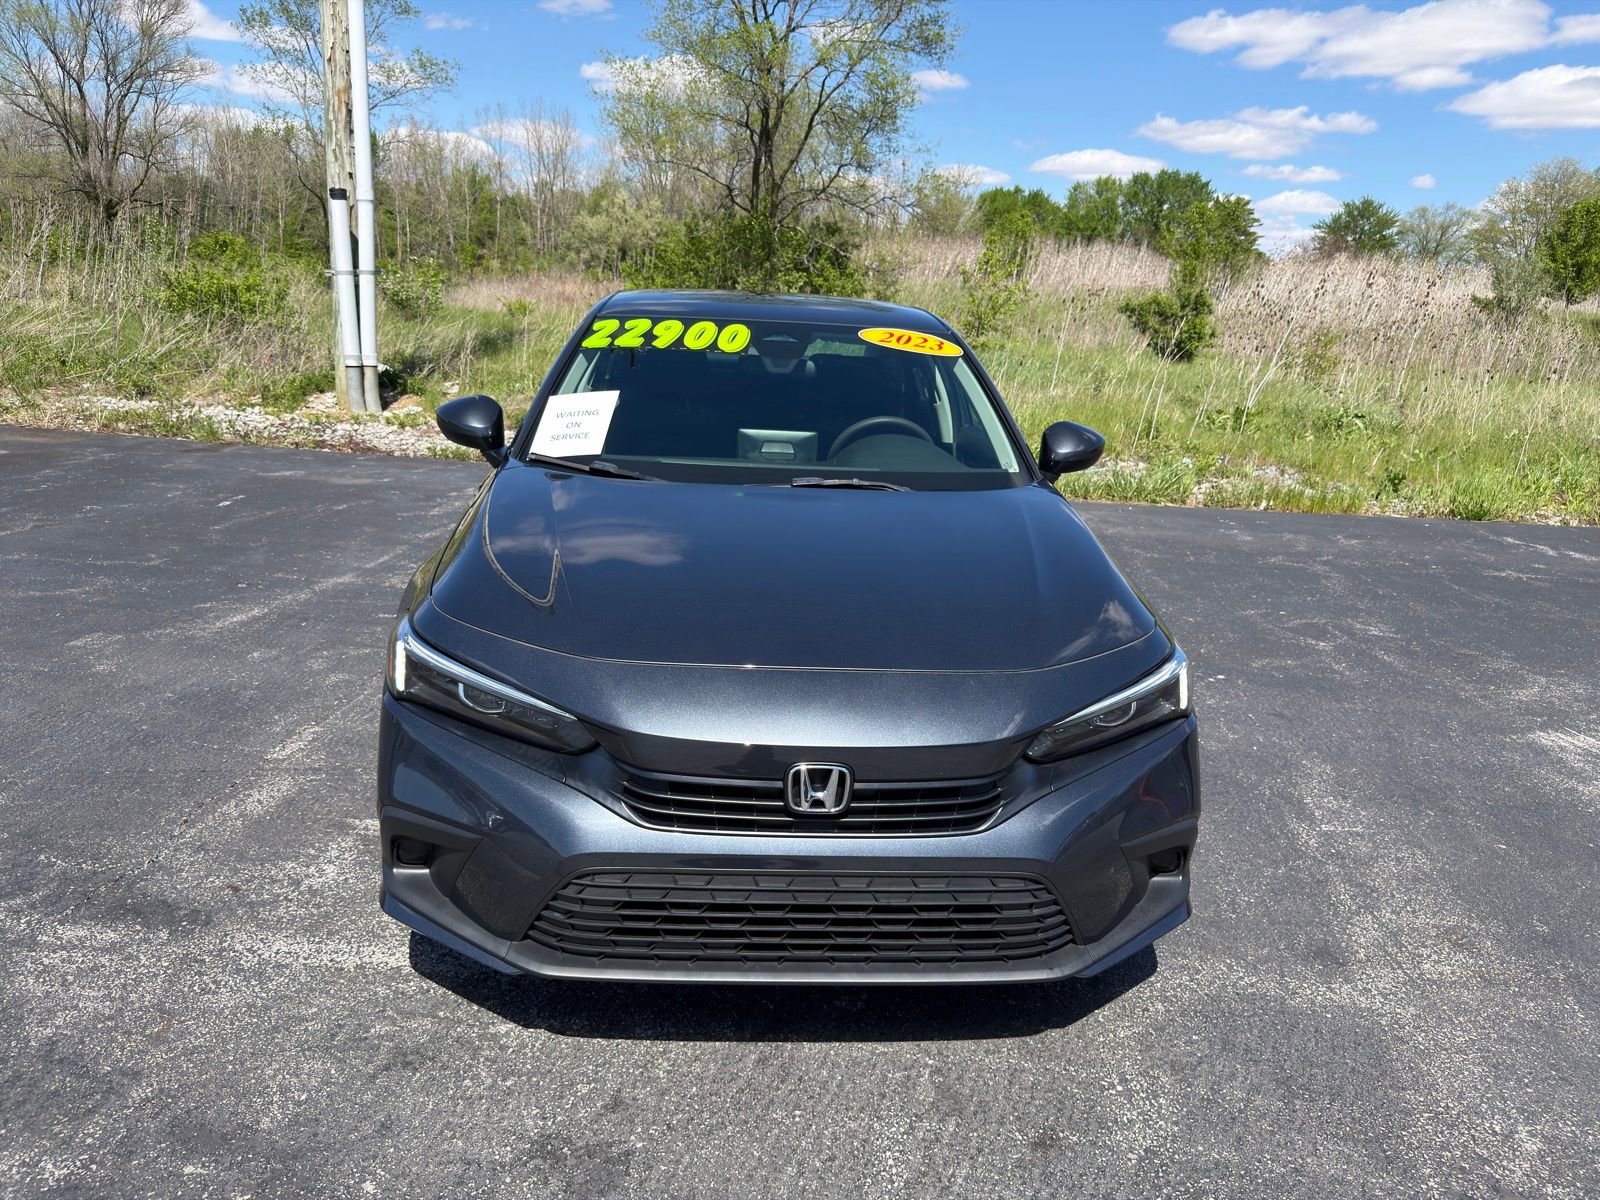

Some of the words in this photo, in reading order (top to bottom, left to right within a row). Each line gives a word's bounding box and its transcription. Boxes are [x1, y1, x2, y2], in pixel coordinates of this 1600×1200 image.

[581, 318, 751, 353] 22900
[878, 331, 945, 351] 2023
[556, 409, 600, 419] WAITING
[565, 421, 582, 429] ON
[549, 431, 591, 442] SERVICE
